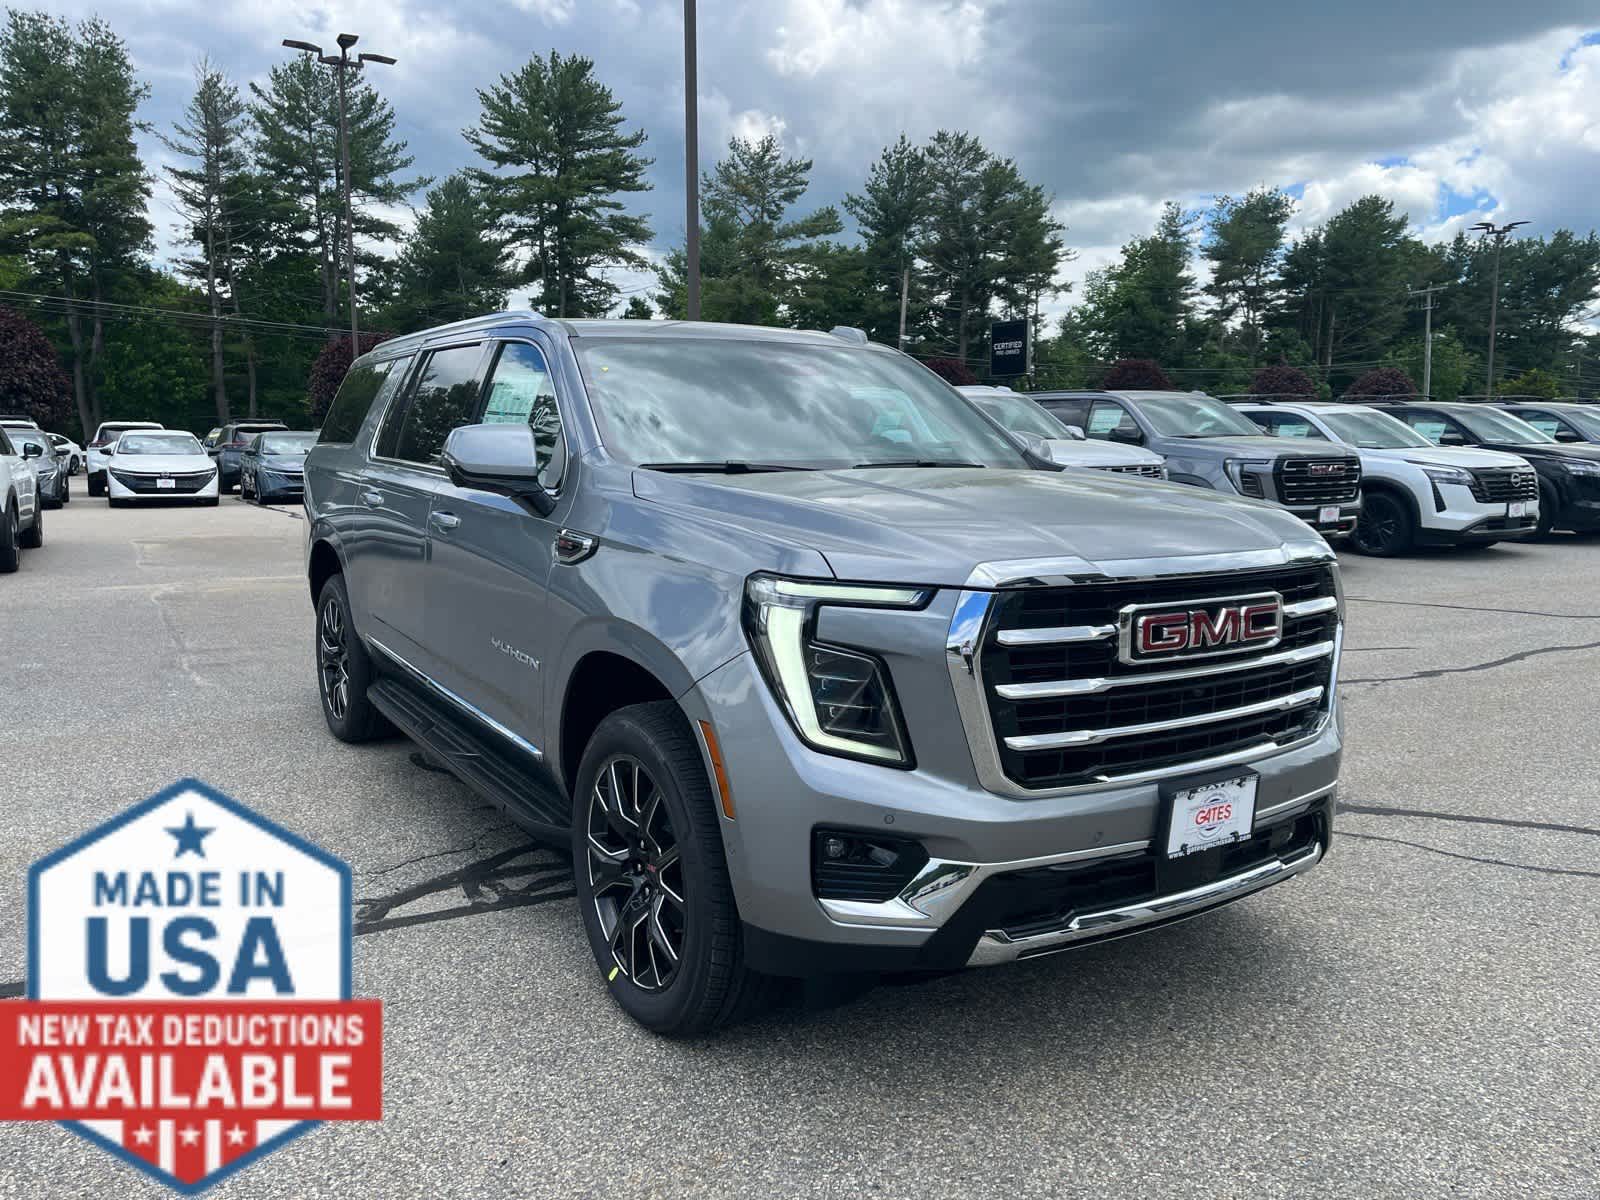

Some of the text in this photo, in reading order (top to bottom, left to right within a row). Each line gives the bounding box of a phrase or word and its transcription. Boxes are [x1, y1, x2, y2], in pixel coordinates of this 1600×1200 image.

[993, 341, 1023, 350] CERTIFIED
[1311, 464, 1345, 476] GMC
[1137, 602, 1280, 653] GMC
[490, 636, 540, 671] YUKON
[1195, 804, 1232, 825] GATES
